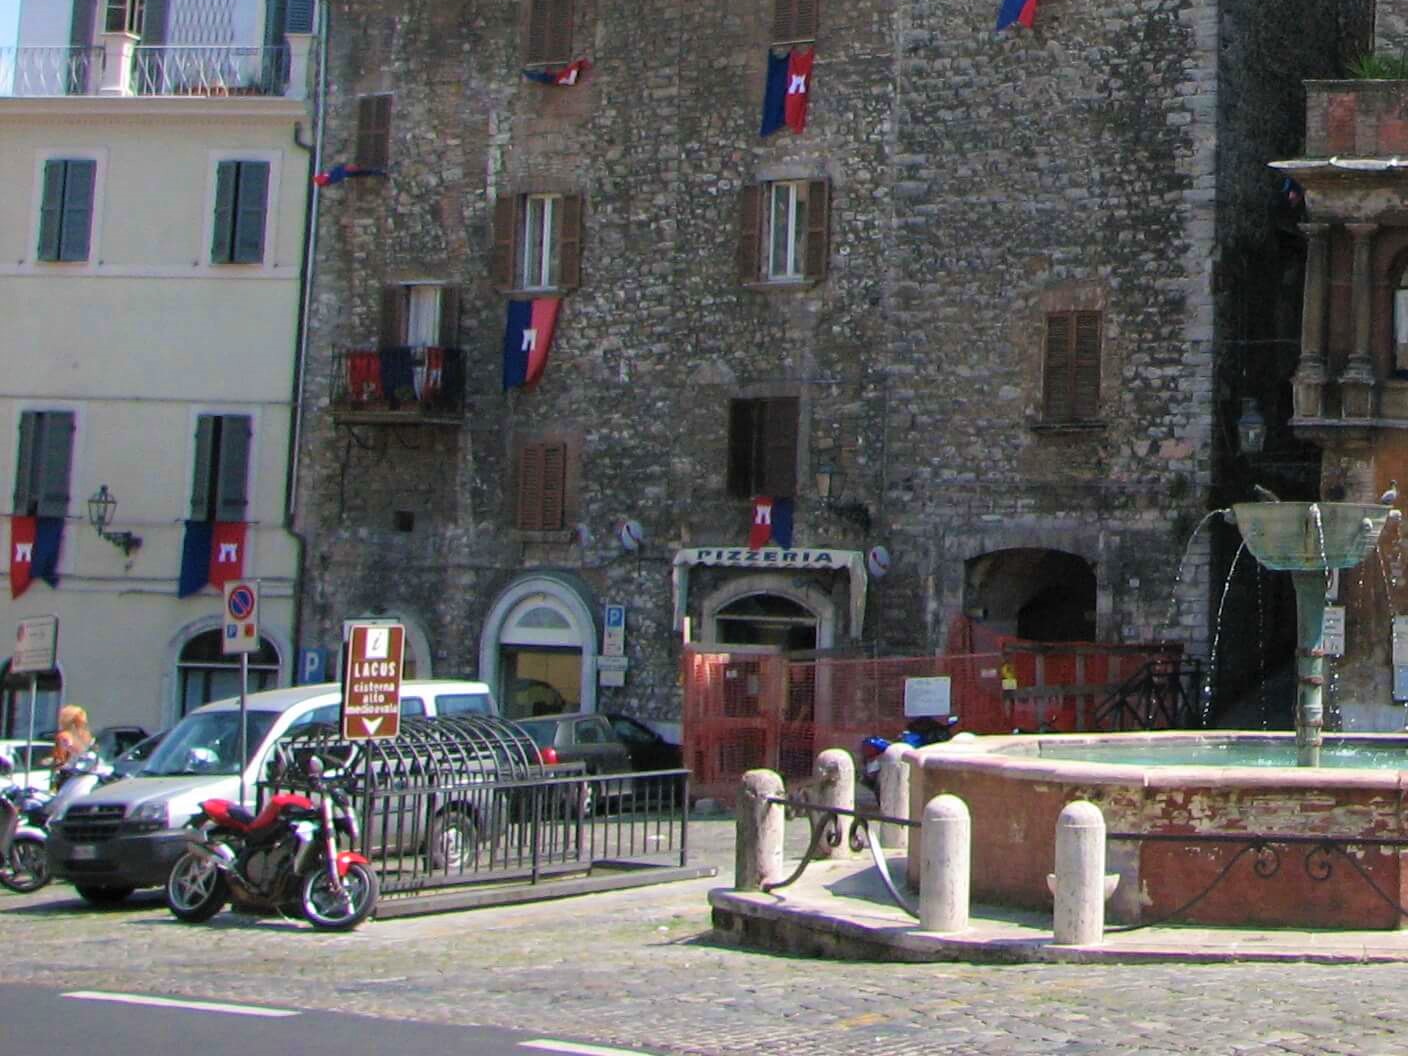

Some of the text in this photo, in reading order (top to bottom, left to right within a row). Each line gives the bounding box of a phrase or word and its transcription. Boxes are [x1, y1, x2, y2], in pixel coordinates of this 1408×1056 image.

[697, 550, 833, 562] PIZZERIA
[305, 652, 319, 680] P
[354, 661, 397, 678] LACUS
[353, 681, 396, 693] cisterna
[363, 693, 385, 703] alto
